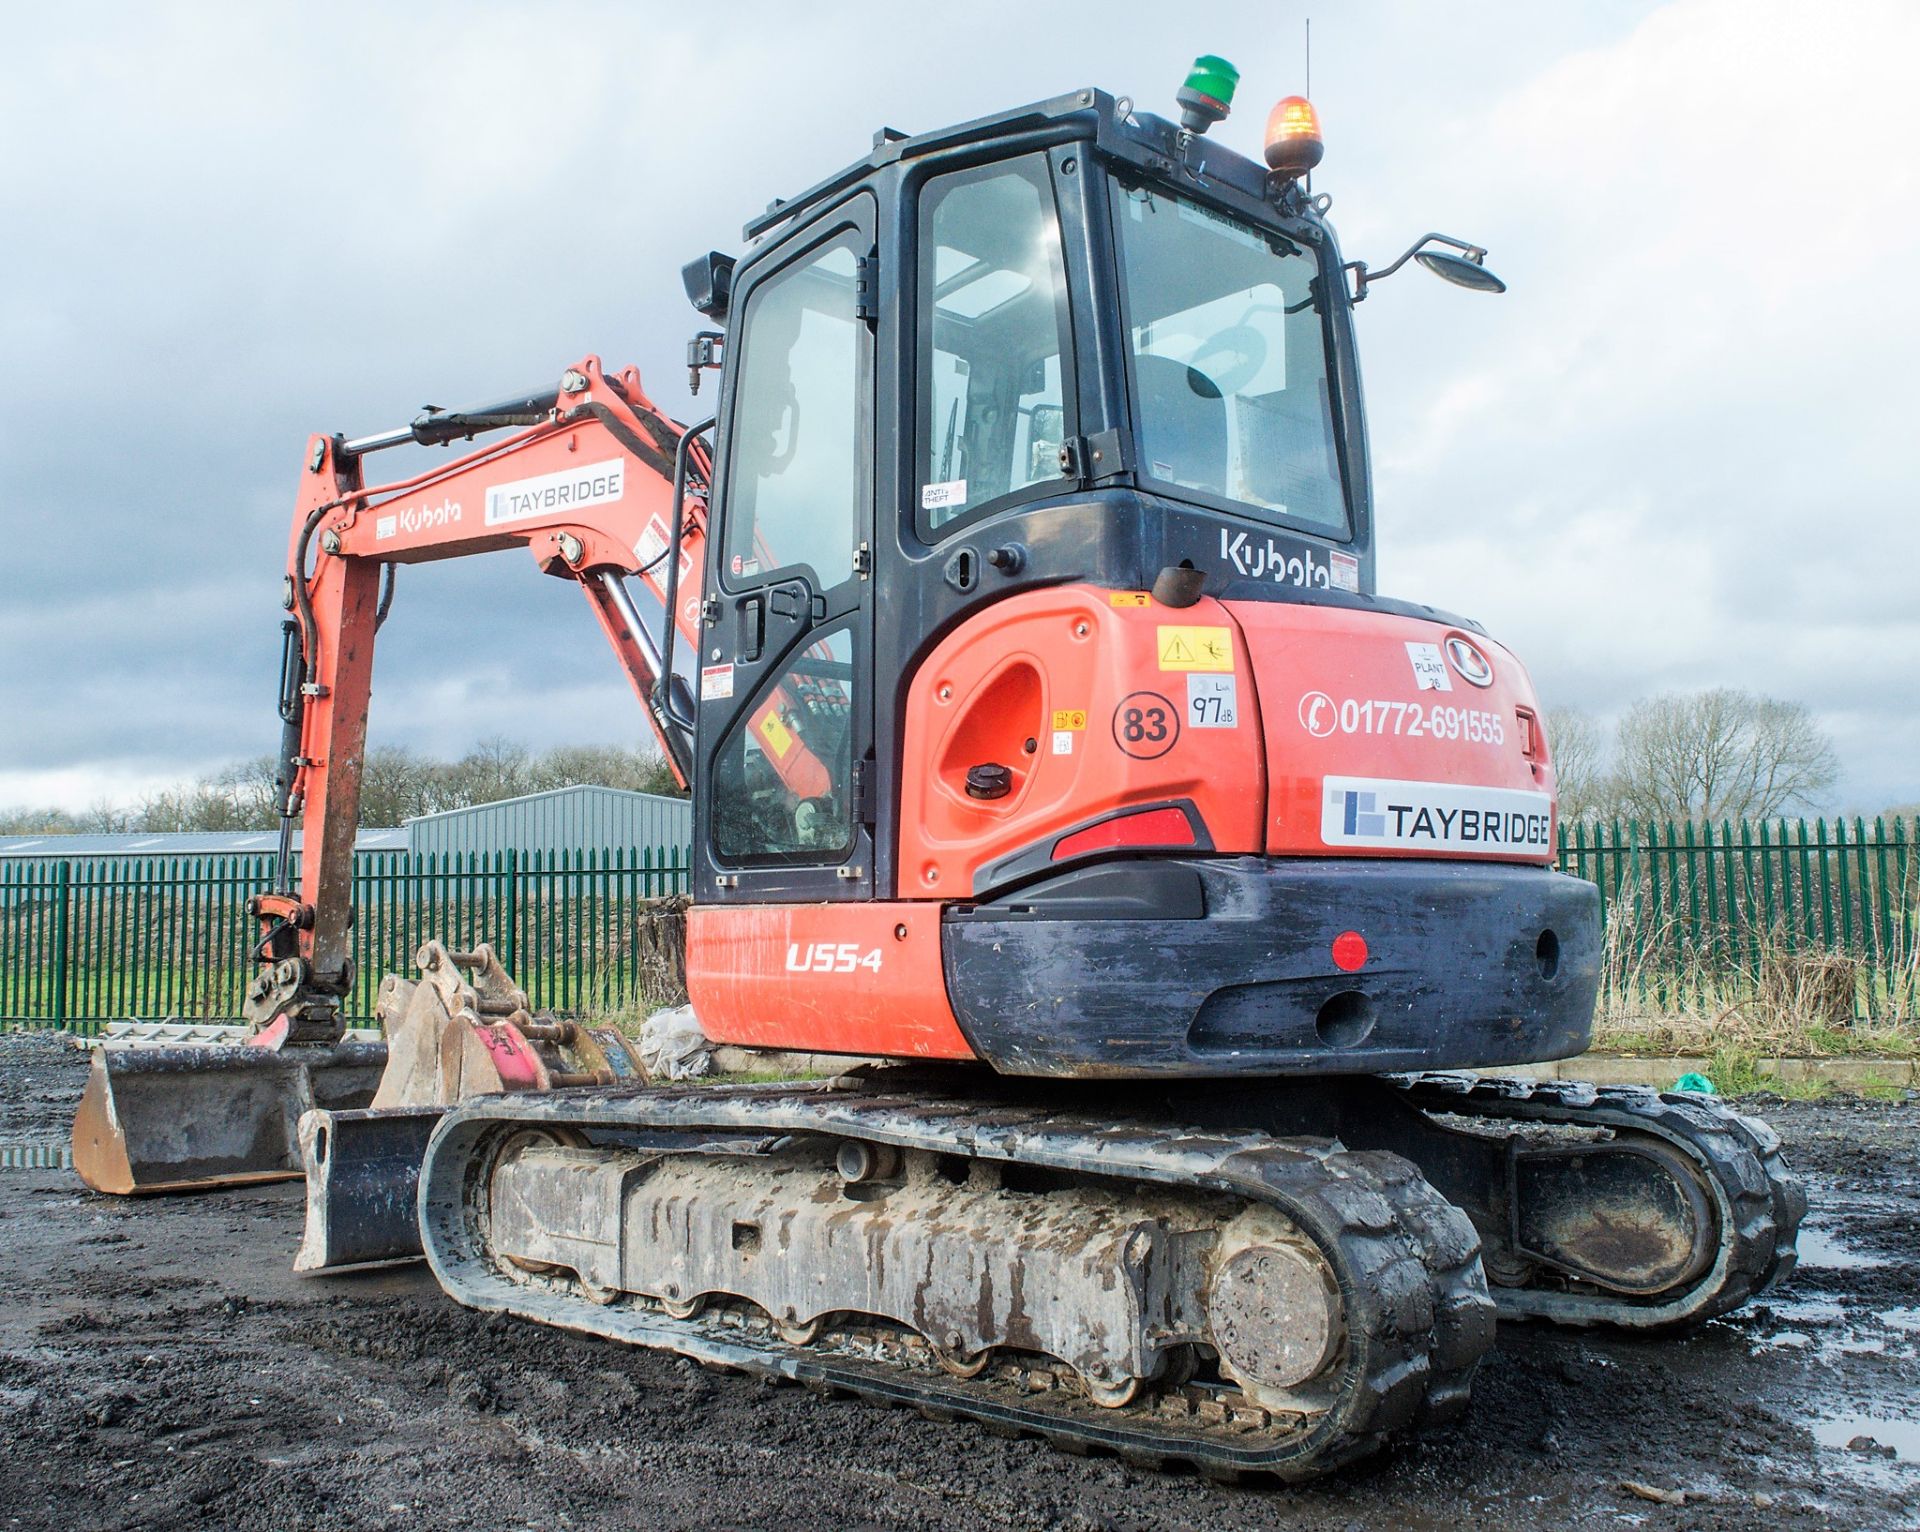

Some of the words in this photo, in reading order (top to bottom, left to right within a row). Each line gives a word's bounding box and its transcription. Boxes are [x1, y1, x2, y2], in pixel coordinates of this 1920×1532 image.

[510, 474, 620, 514] TAYBRIDGE
[924, 494, 949, 505] THEFT
[400, 499, 462, 533] Kubota
[1220, 528, 1330, 590] Kubota
[1415, 662, 1444, 674] PLANT
[1123, 707, 1168, 742] 83
[1193, 697, 1221, 723] 97
[1340, 698, 1504, 746] 01772-691555
[1387, 804, 1549, 845] TAYBRIDGE
